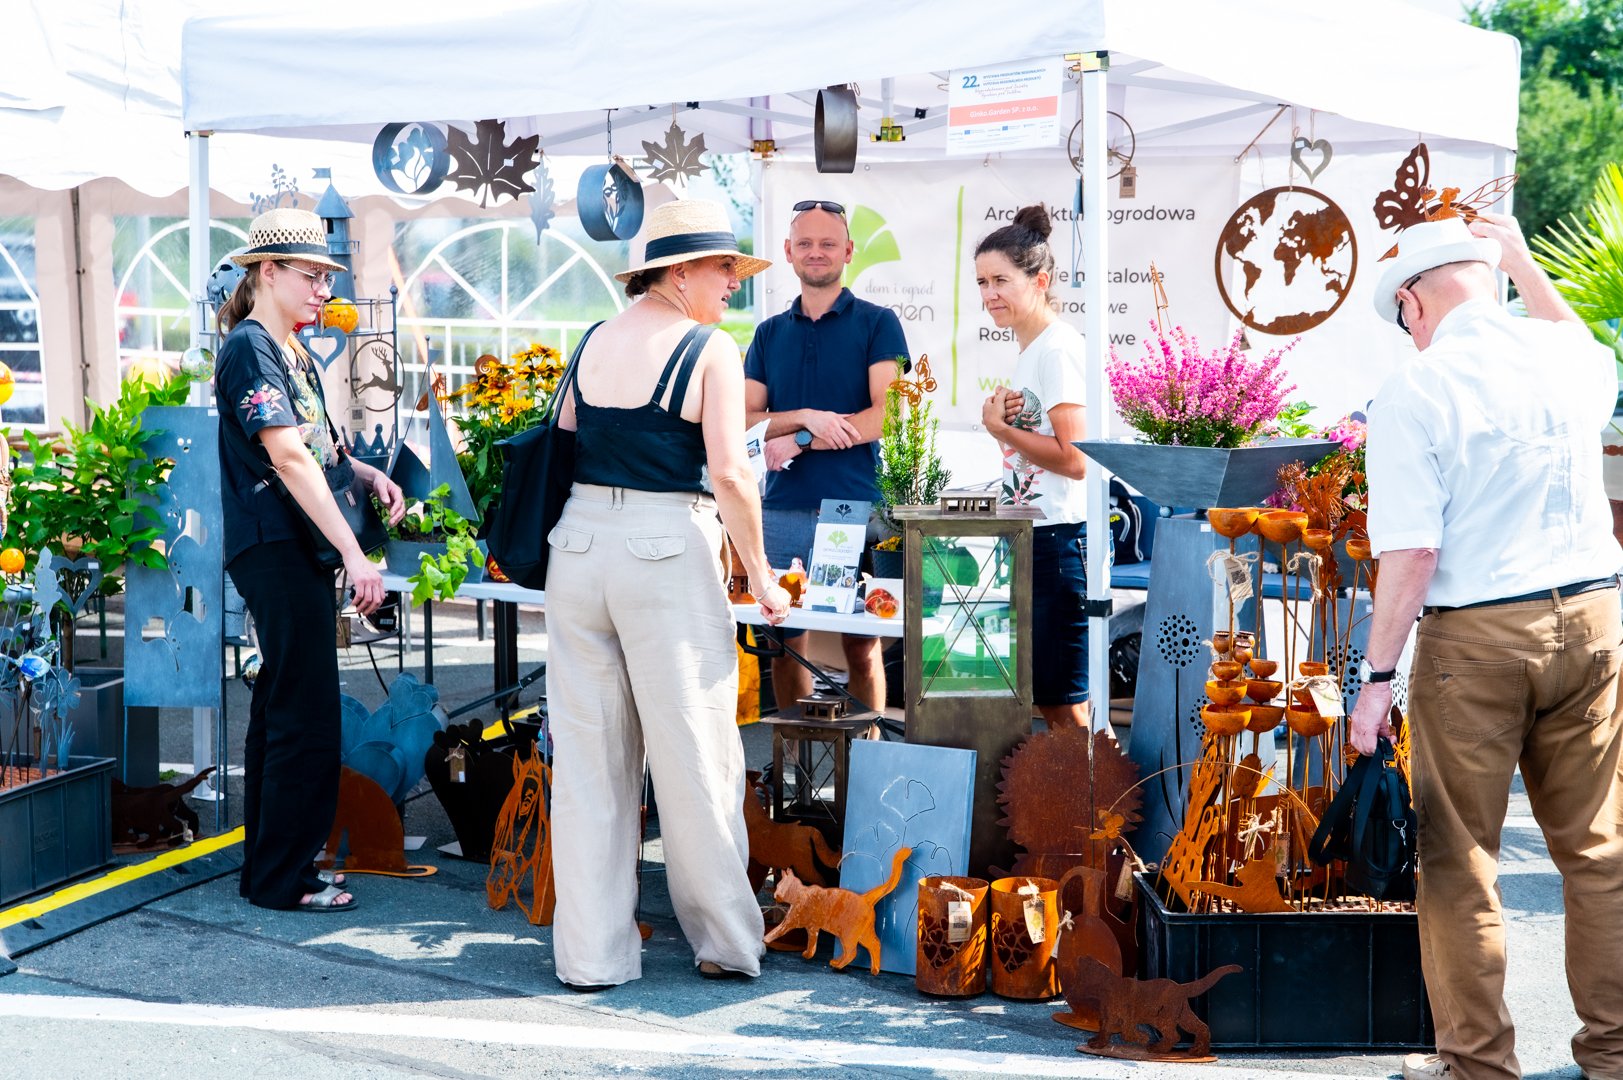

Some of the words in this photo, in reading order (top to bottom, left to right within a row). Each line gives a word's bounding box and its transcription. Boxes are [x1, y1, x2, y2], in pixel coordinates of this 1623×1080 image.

[962, 75, 980, 89] 22.
[988, 108, 1010, 116] Garden
[865, 279, 889, 295] dom
[901, 280, 934, 303] ogród
